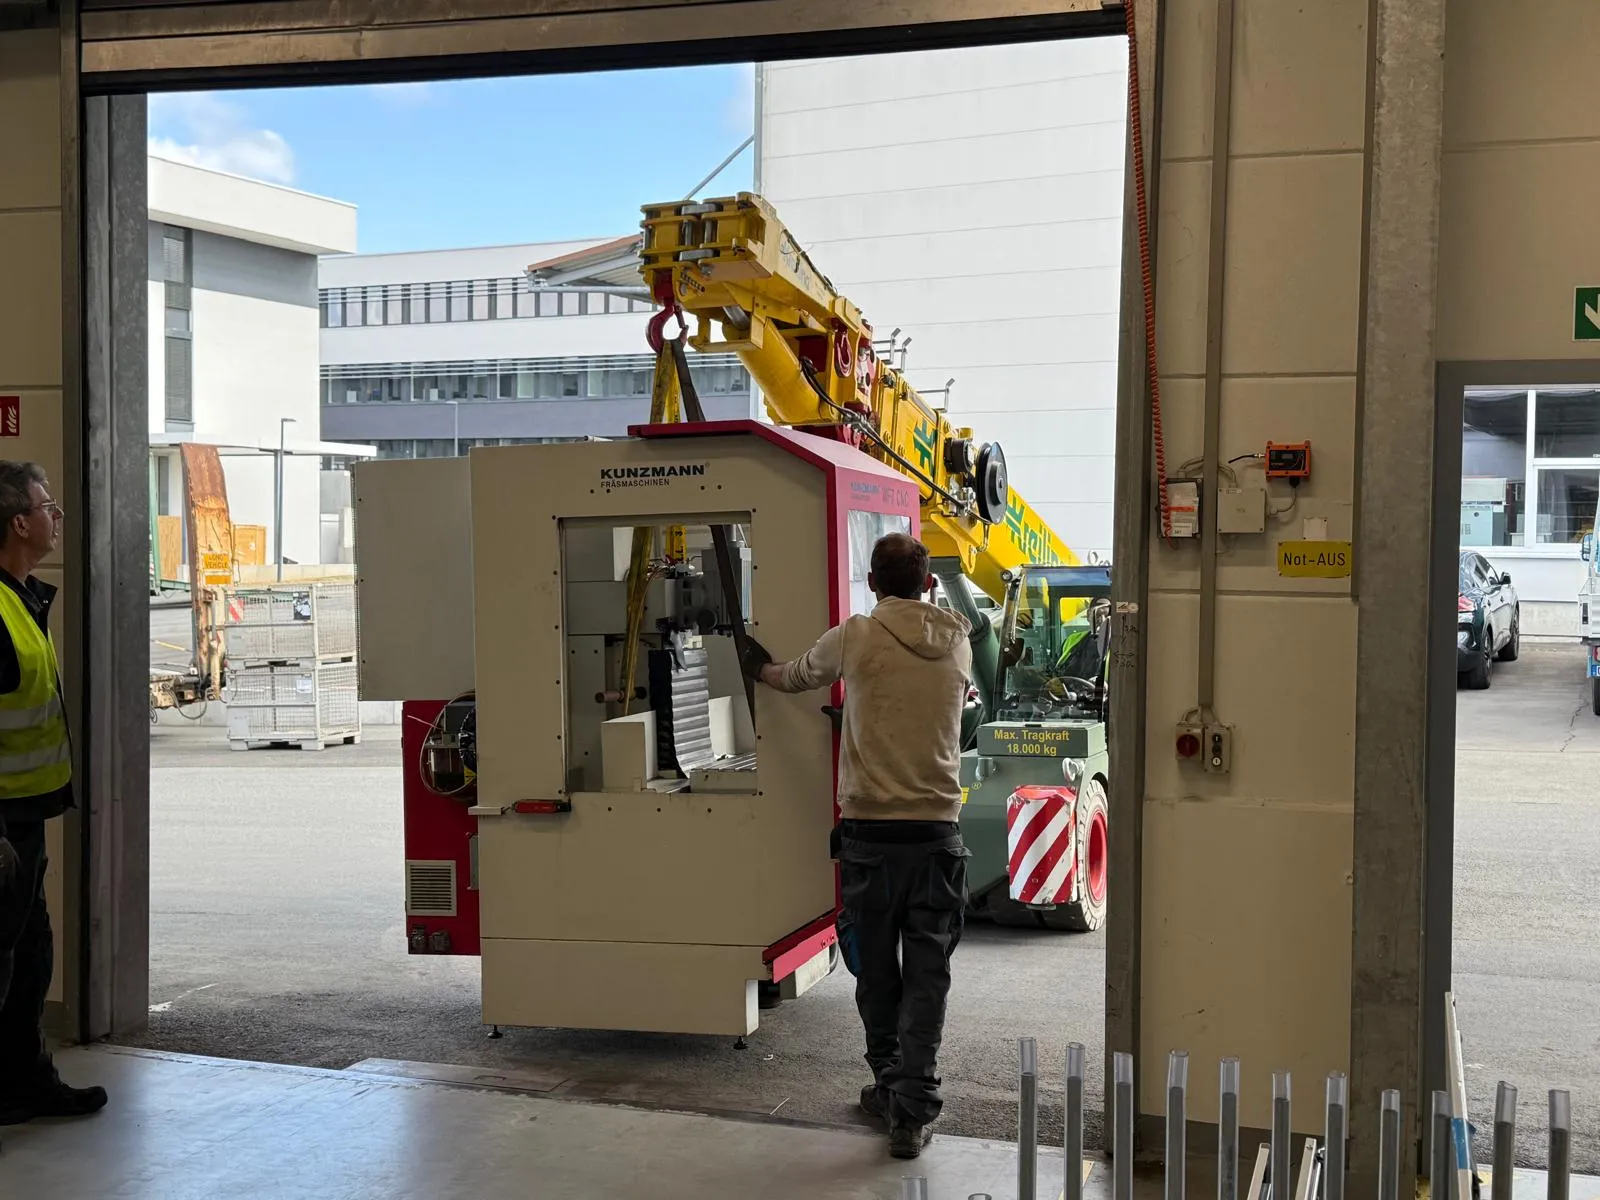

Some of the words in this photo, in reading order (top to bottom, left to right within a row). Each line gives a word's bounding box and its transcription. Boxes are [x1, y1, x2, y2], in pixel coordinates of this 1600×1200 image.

[601, 464, 705, 479] KUNZMANN
[601, 478, 670, 488] FRÄSMASCHINEN
[1284, 552, 1346, 566] Not-AUS
[994, 729, 1019, 740] Max.
[1022, 729, 1070, 742] Tragkraft
[1007, 743, 1041, 754] 18.000
[1043, 744, 1057, 756] kg
